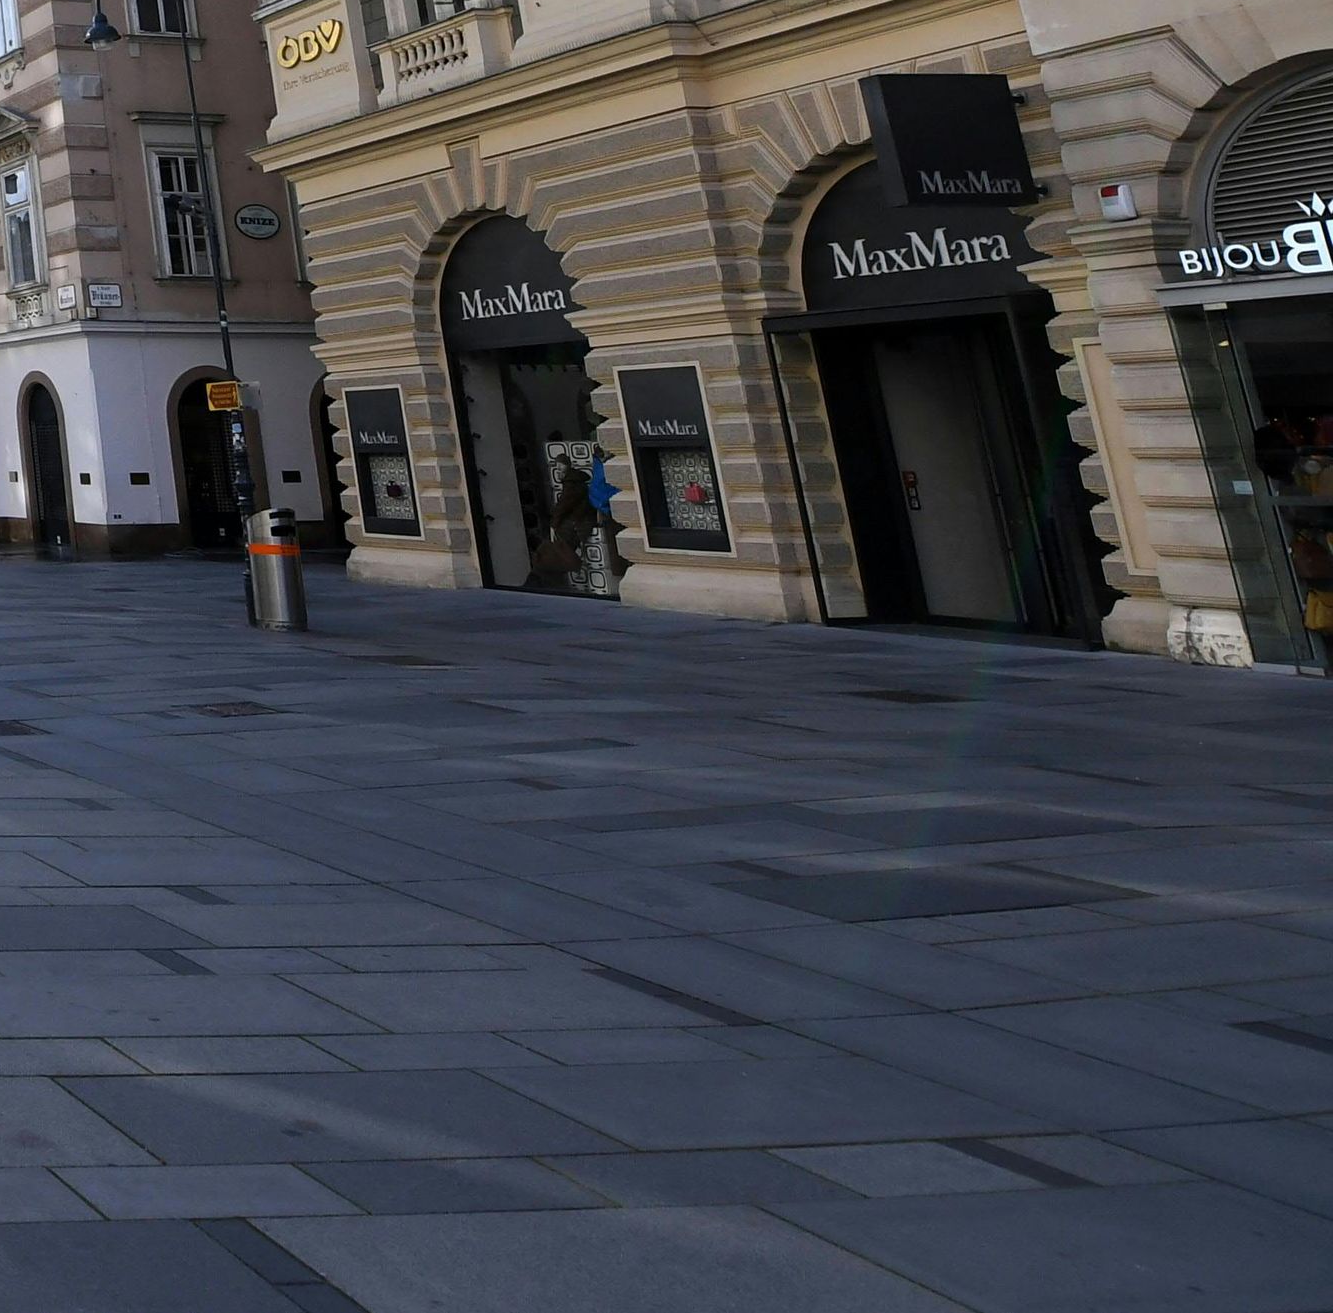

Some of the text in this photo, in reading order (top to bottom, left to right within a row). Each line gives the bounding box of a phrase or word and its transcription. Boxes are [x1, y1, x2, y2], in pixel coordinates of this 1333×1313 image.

[918, 170, 1023, 195] MaxMara
[240, 216, 275, 226] KNIZE
[828, 227, 1012, 280] MaxMara
[1178, 240, 1281, 277] BIJOU
[458, 282, 566, 321] MaxMara
[359, 431, 399, 445] MaxMara
[638, 419, 699, 436] MaxMara
